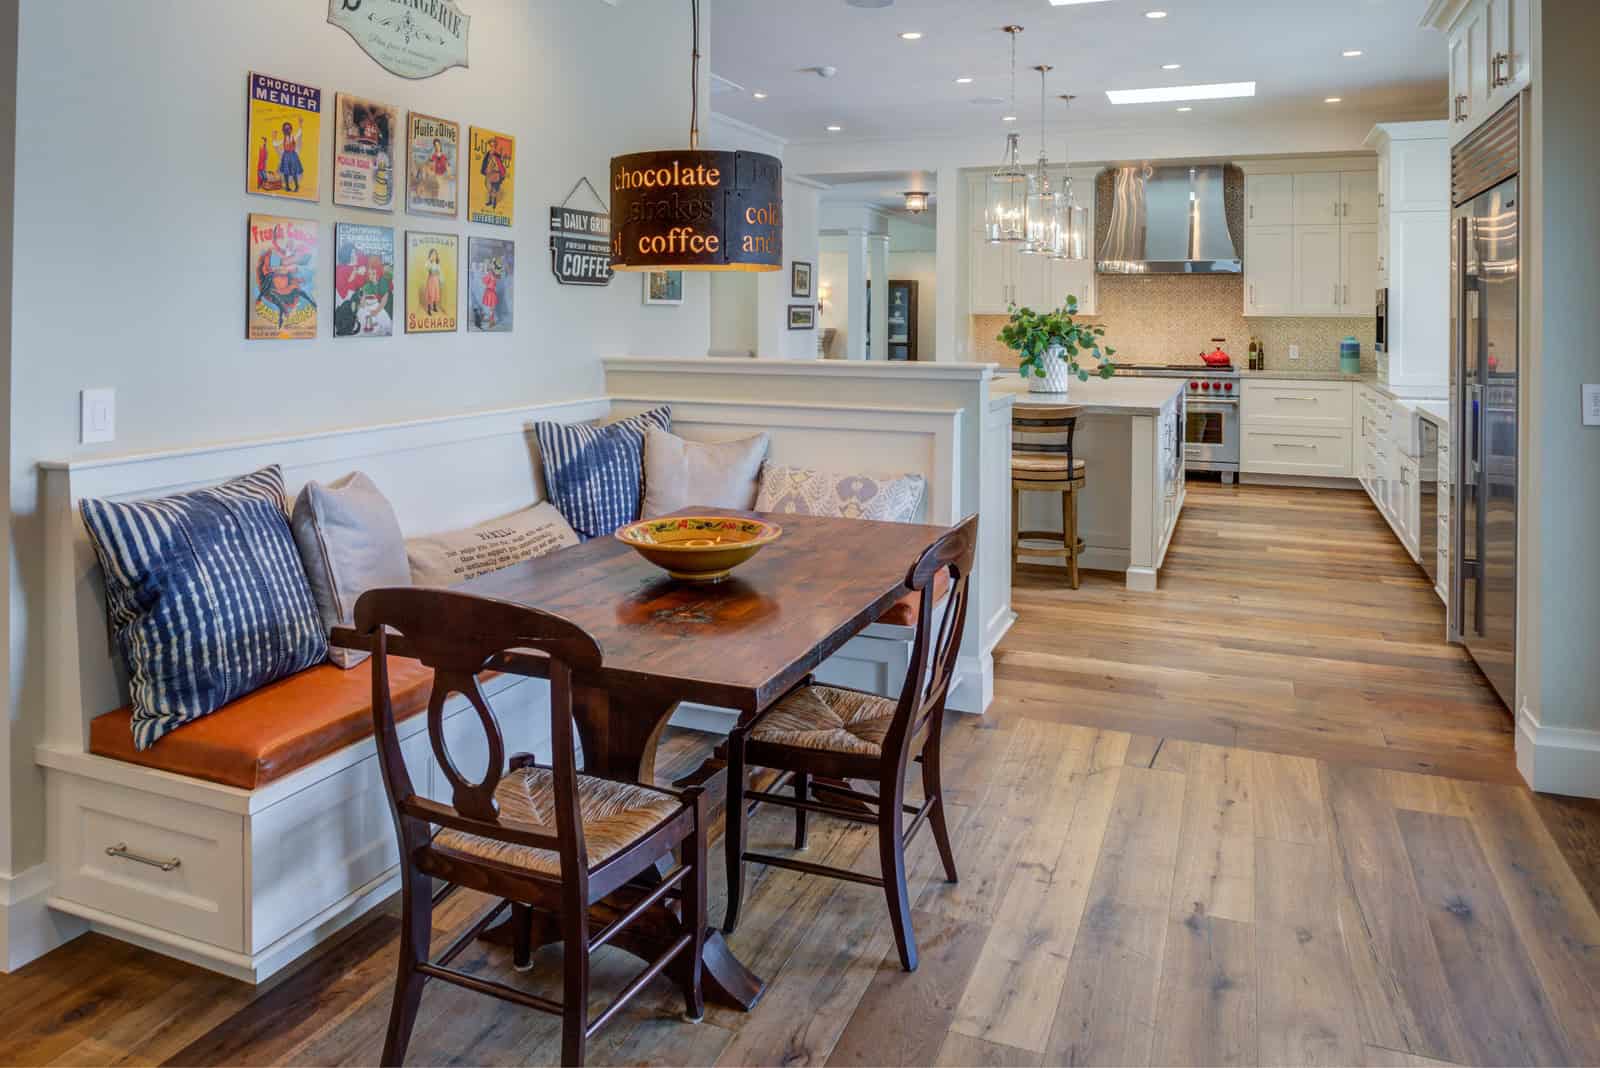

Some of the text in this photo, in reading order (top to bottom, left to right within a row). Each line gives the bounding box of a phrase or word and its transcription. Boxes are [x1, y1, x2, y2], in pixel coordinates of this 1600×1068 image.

[256, 87, 317, 111] MENIER
[259, 77, 315, 97] CHOCOLAT
[615, 160, 720, 190] chocolate
[563, 213, 610, 233] DAILY GRIN
[639, 226, 720, 254] coffee
[562, 254, 610, 278] COFFEE
[409, 313, 455, 329] SUCHARD
